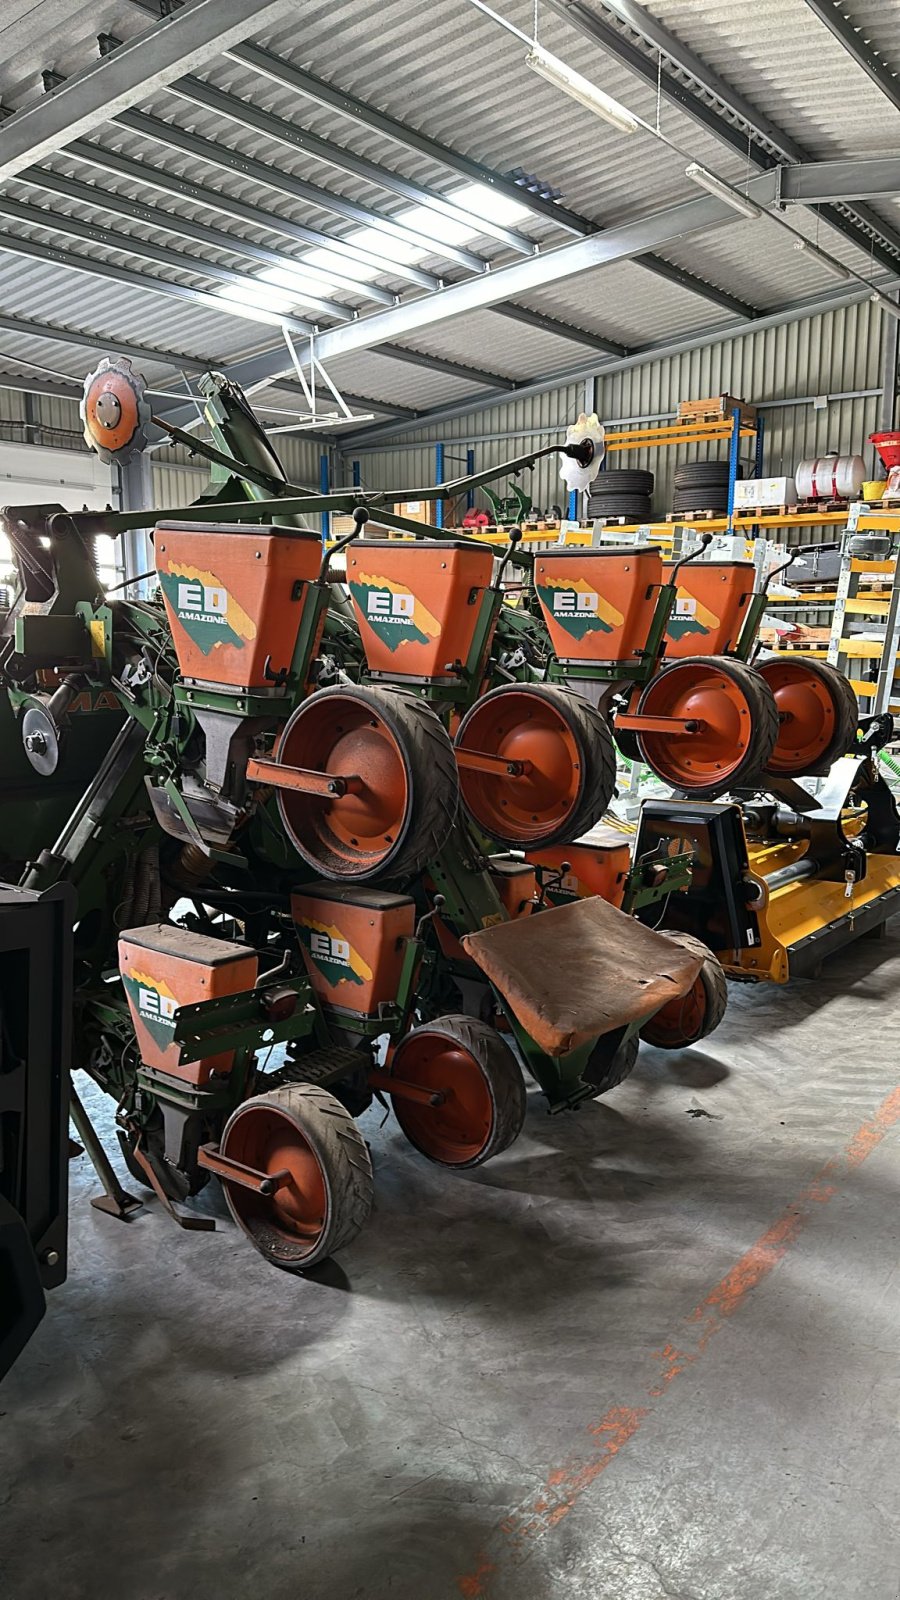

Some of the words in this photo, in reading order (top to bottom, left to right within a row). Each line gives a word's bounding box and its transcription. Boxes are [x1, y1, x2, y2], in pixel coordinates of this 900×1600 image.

[178, 583, 227, 615] ED
[367, 591, 414, 616] ED
[553, 592, 598, 611] ED
[671, 598, 697, 615] D
[178, 611, 228, 625] AMAZONE
[367, 614, 414, 626] AMAZONE
[553, 611, 598, 619] AMAZONE
[310, 933, 350, 960] ED
[311, 953, 351, 968] AMAZONE
[139, 987, 179, 1020] ED
